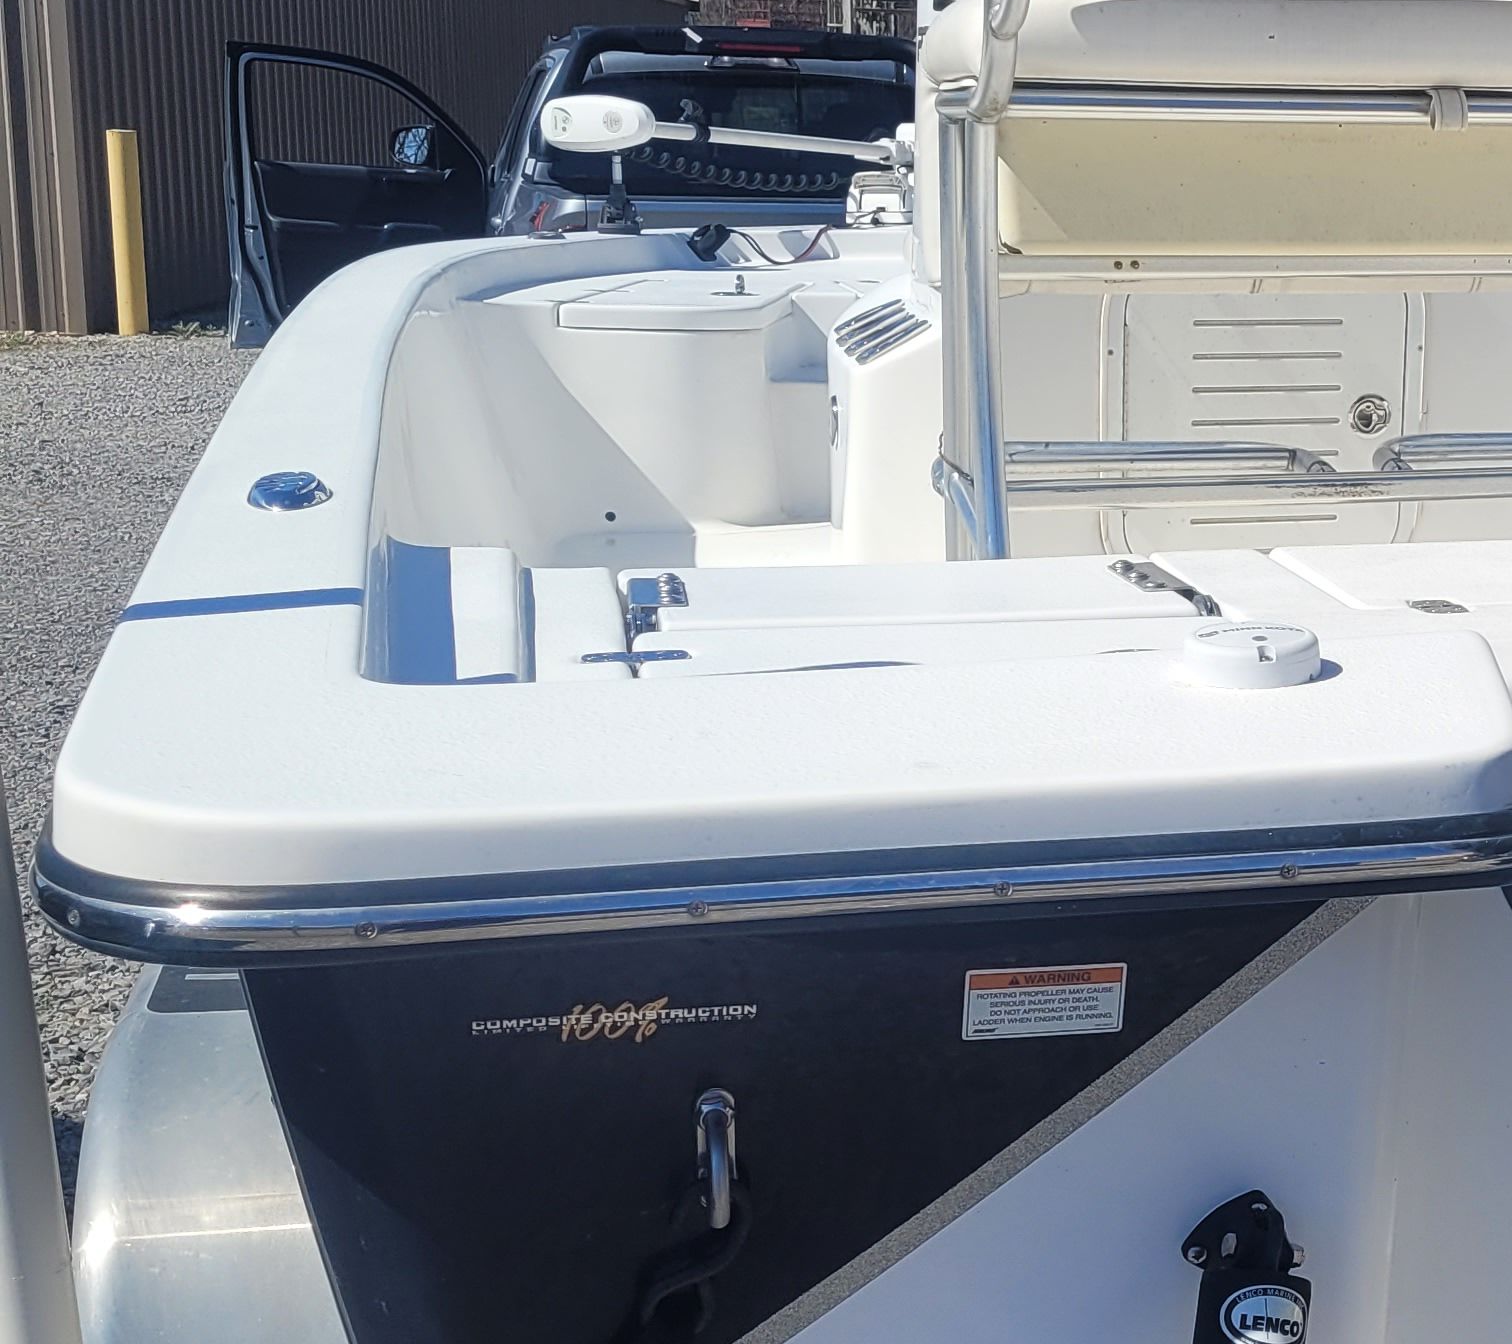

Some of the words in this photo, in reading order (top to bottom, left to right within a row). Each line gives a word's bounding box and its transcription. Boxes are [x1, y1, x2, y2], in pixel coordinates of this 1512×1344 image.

[1024, 972, 1092, 985] WARNING
[977, 991, 1017, 1000] ROTATING
[1019, 988, 1067, 998] PROPELLER
[1068, 987, 1086, 996] MAY
[1087, 986, 1114, 994] CAUSE
[989, 1000, 1026, 1008] SERIOUS
[1027, 998, 1057, 1007] INJURY
[1058, 997, 1070, 1005] OR
[471, 1014, 593, 1030] COMPOSITE
[601, 1004, 757, 1023] CONSTRUCTION
[989, 1009, 1003, 1017] DO
[1004, 1008, 1022, 1016] NOT
[1022, 1006, 1067, 1015] APPROACH
[1068, 1005, 1081, 1013] OR
[1082, 1004, 1100, 1012] USE
[561, 996, 669, 1043] 100%
[972, 1017, 1006, 1026] LADDER
[1006, 1016, 1033, 1025] WHEN
[1033, 1014, 1065, 1023] ENGINE
[1239, 1313, 1300, 1338] LENCO
